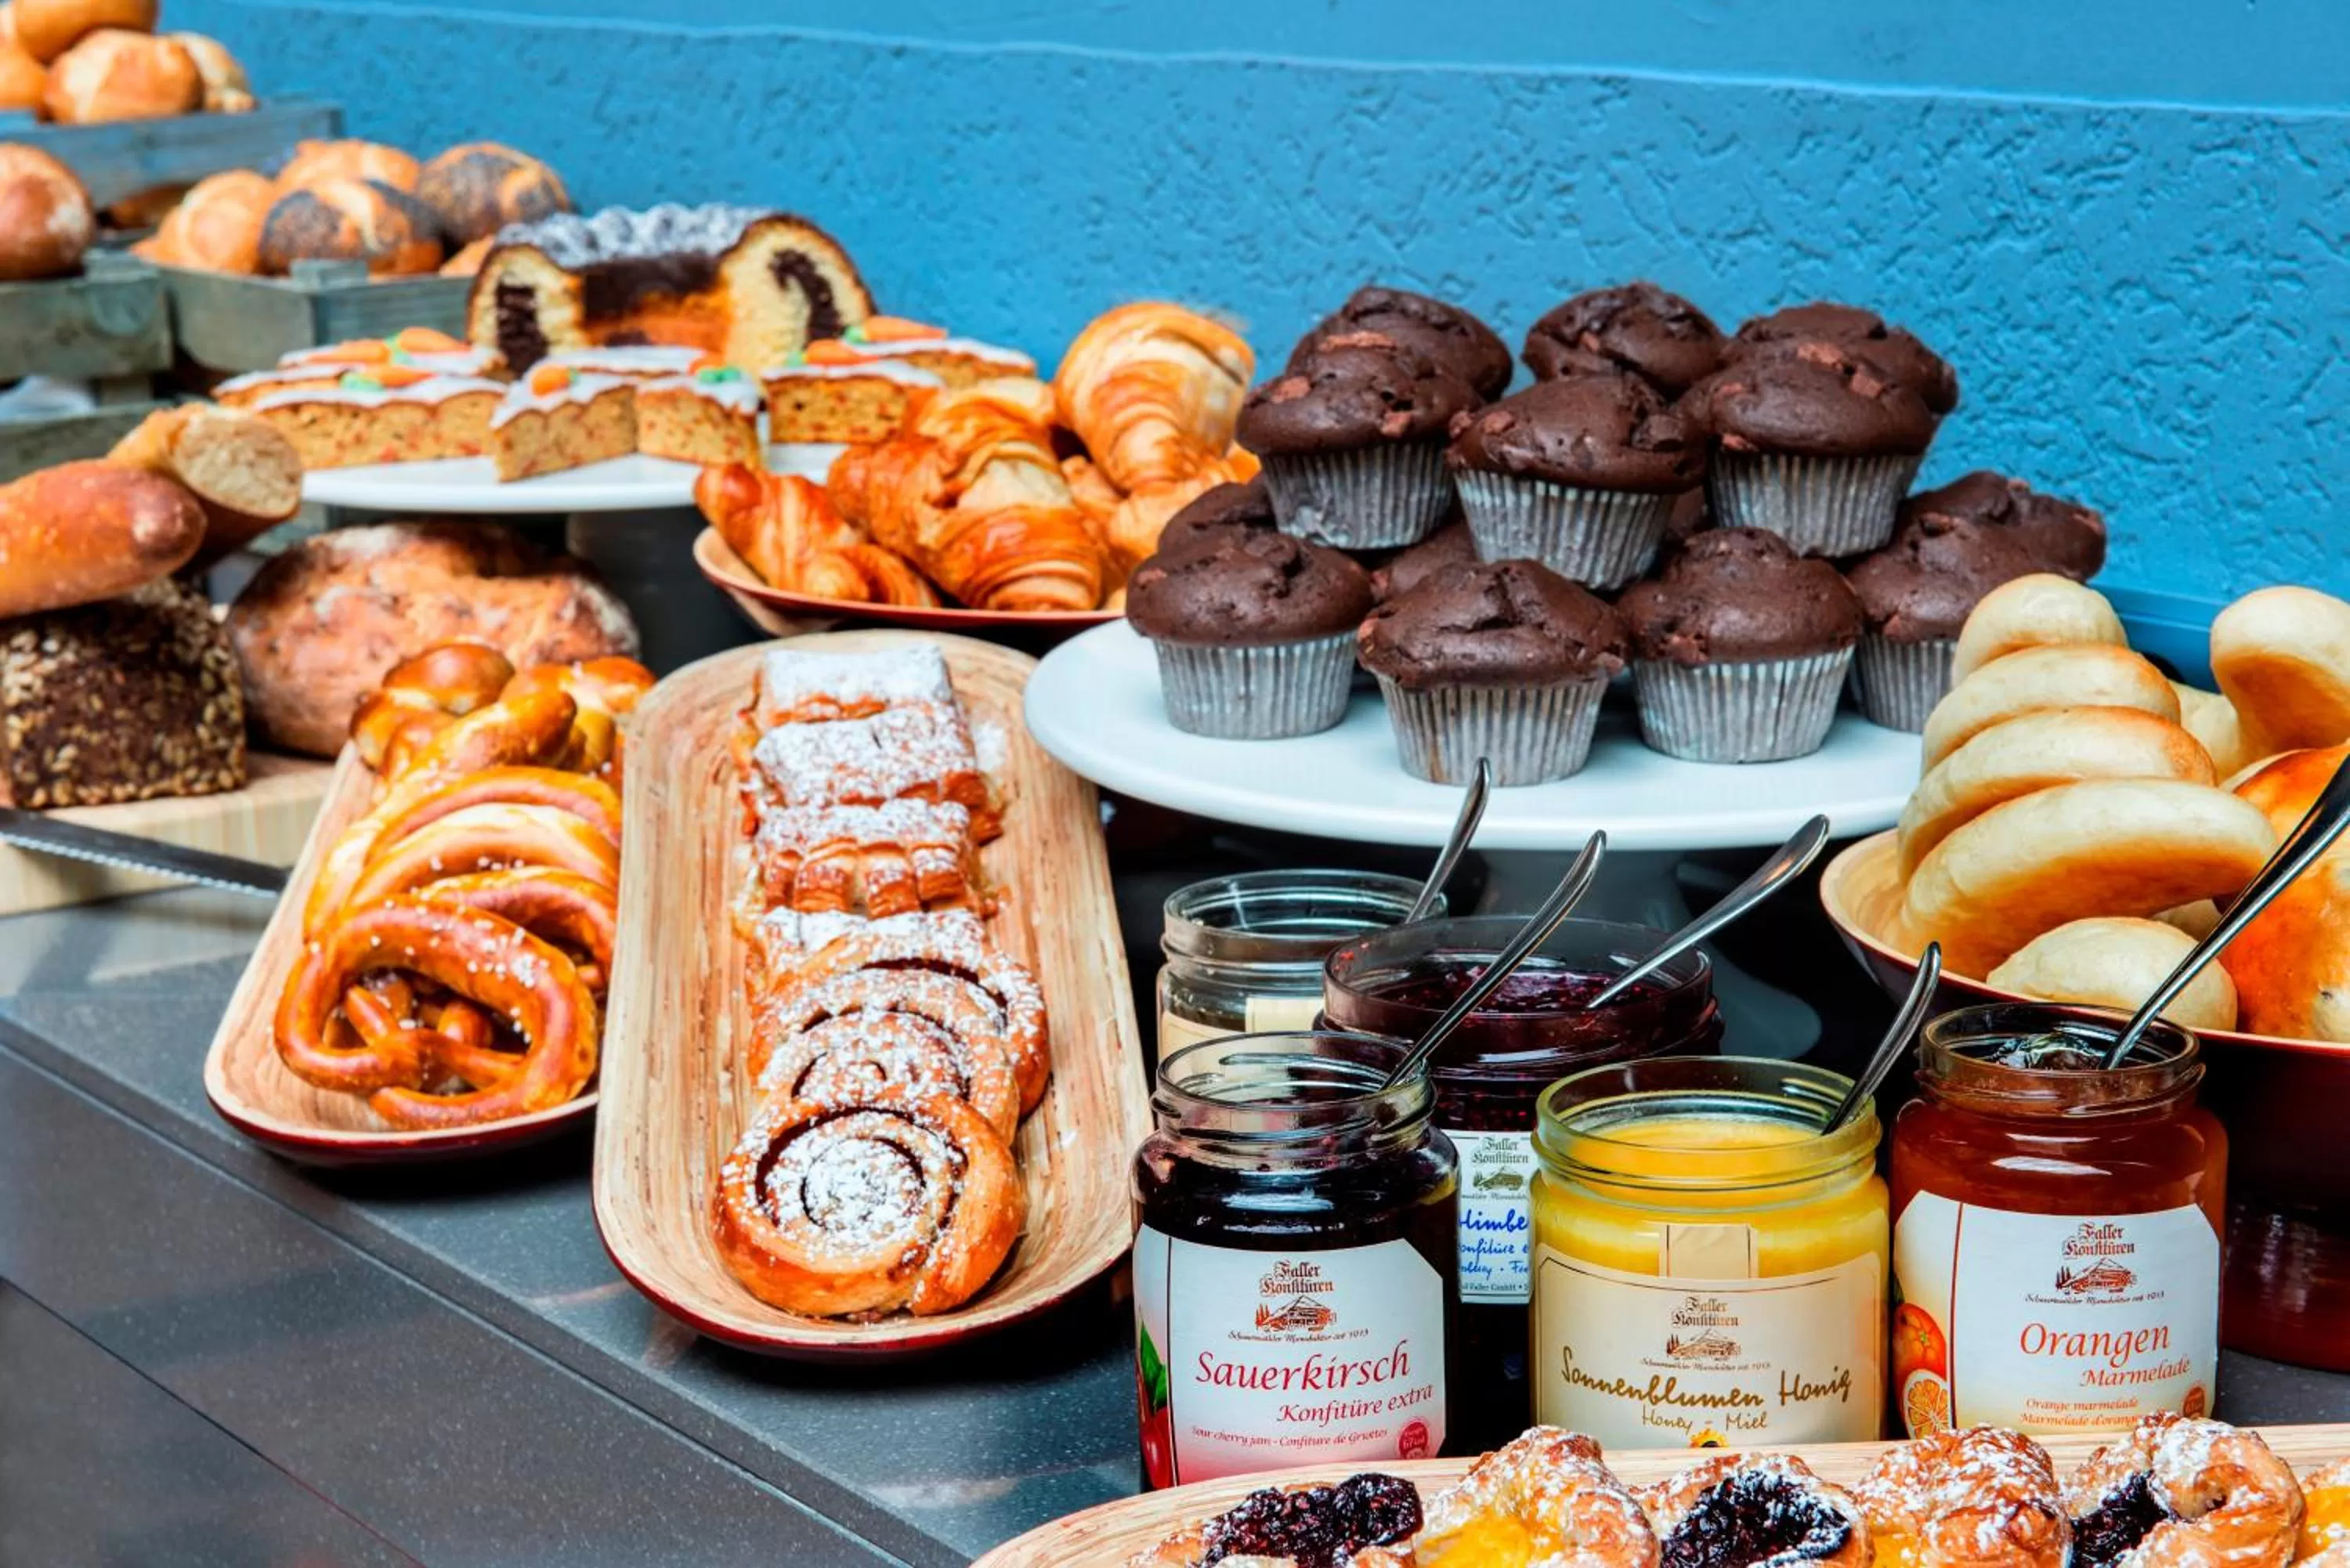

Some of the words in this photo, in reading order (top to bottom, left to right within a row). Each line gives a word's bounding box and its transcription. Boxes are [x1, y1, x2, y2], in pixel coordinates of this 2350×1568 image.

[2077, 1222, 2124, 1241] Faller
[1273, 1259, 1321, 1279] Faller
[1685, 1296, 1728, 1312] Faller
[2020, 1323, 2169, 1367] Orangen
[1195, 1339, 1411, 1390] Sauerkirsch
[2081, 1357, 2191, 1387] Marmelade
[1561, 1346, 1764, 1409] Sonnenblumen
[1779, 1366, 1852, 1406] Honig
[1277, 1399, 1383, 1428] Konfitüre
[1387, 1383, 1434, 1411] extra
[2026, 1397, 2069, 1412] Orange
[2073, 1396, 2138, 1411] marmelade
[1642, 1404, 1692, 1435] Honey
[1725, 1411, 1768, 1432] Miel
[2020, 1412, 2088, 1425] Marmelade
[1213, 1429, 1247, 1447] cherry
[1249, 1434, 1271, 1447] jam
[1279, 1434, 1330, 1449] Confiture
[1333, 1432, 1347, 1445] de
